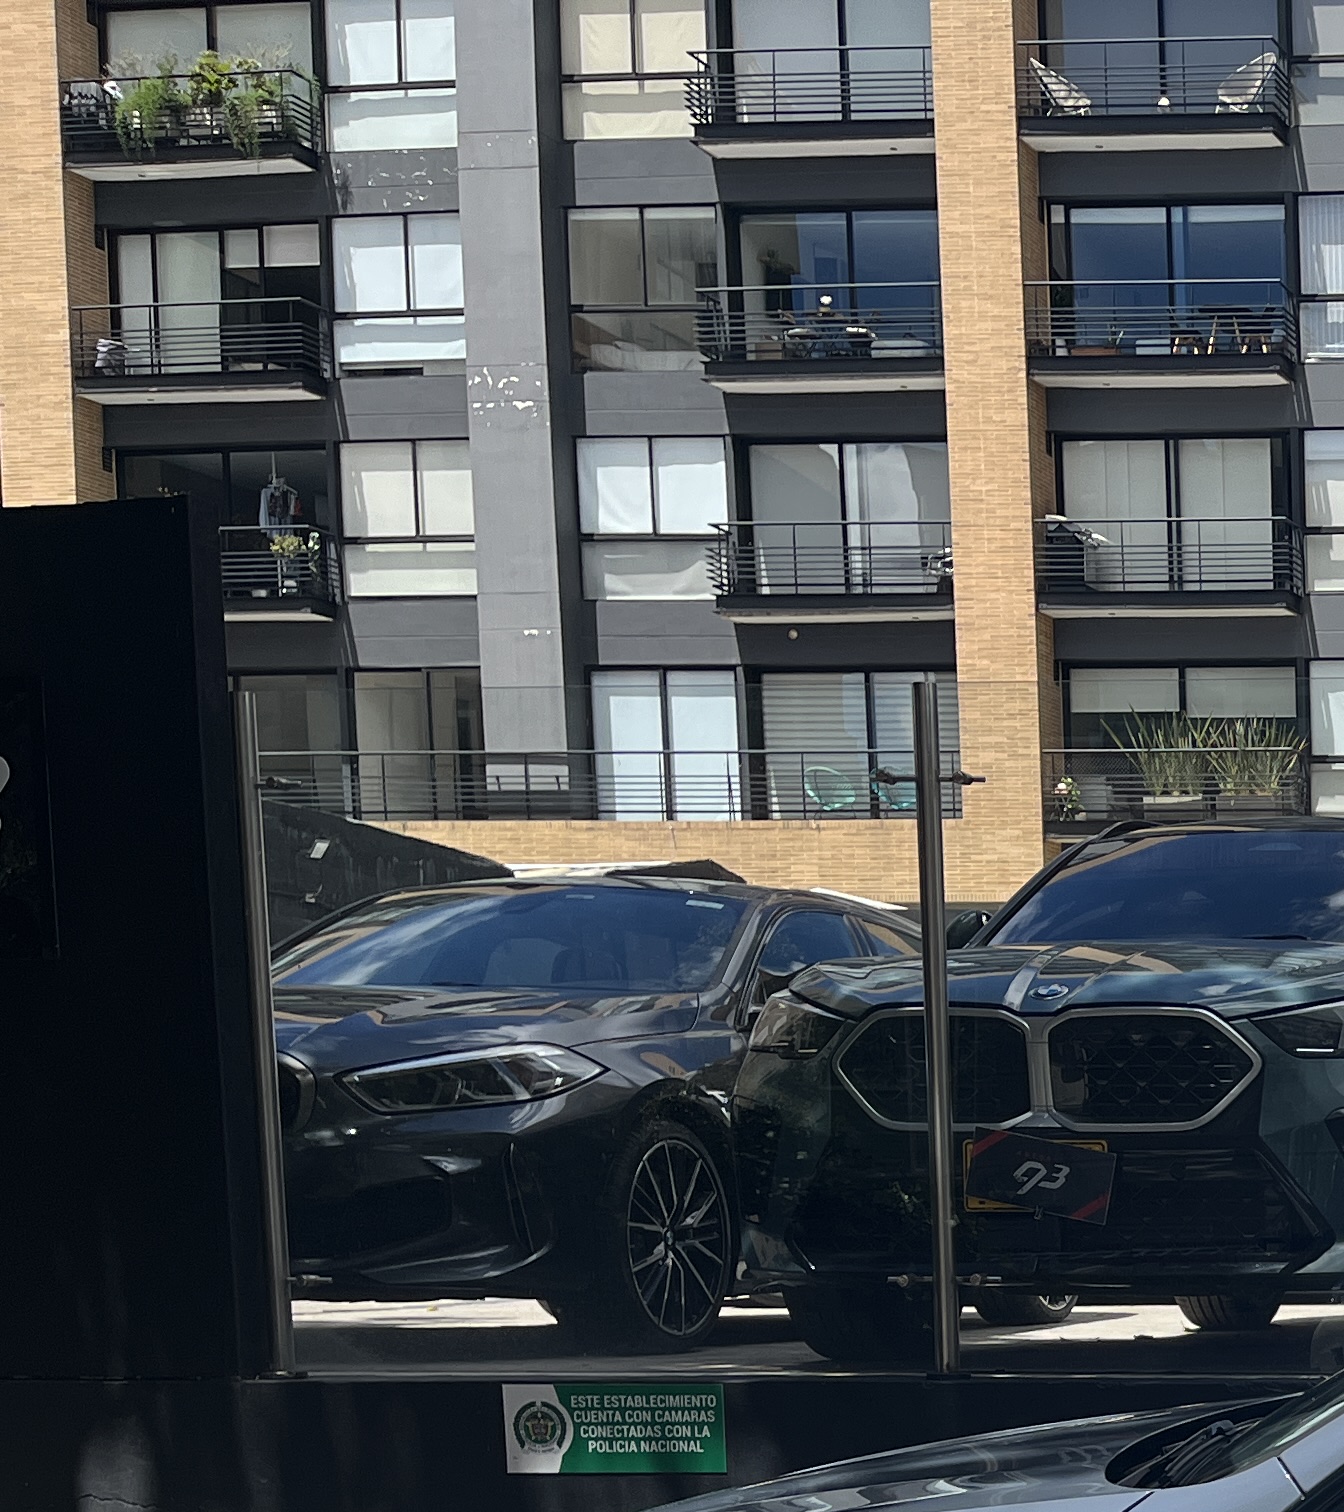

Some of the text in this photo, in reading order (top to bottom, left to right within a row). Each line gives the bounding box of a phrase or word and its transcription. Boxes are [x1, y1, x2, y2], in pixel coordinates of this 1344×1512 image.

[1012, 1160, 1071, 1195] 93
[570, 1394, 717, 1408] ESTE ESTABLECIMIENTO
[573, 1410, 716, 1423] CUENTA CON CAMARAS
[580, 1425, 711, 1438] CONECTADAS CON LA
[588, 1440, 704, 1453] POLICIA NACIONAL
